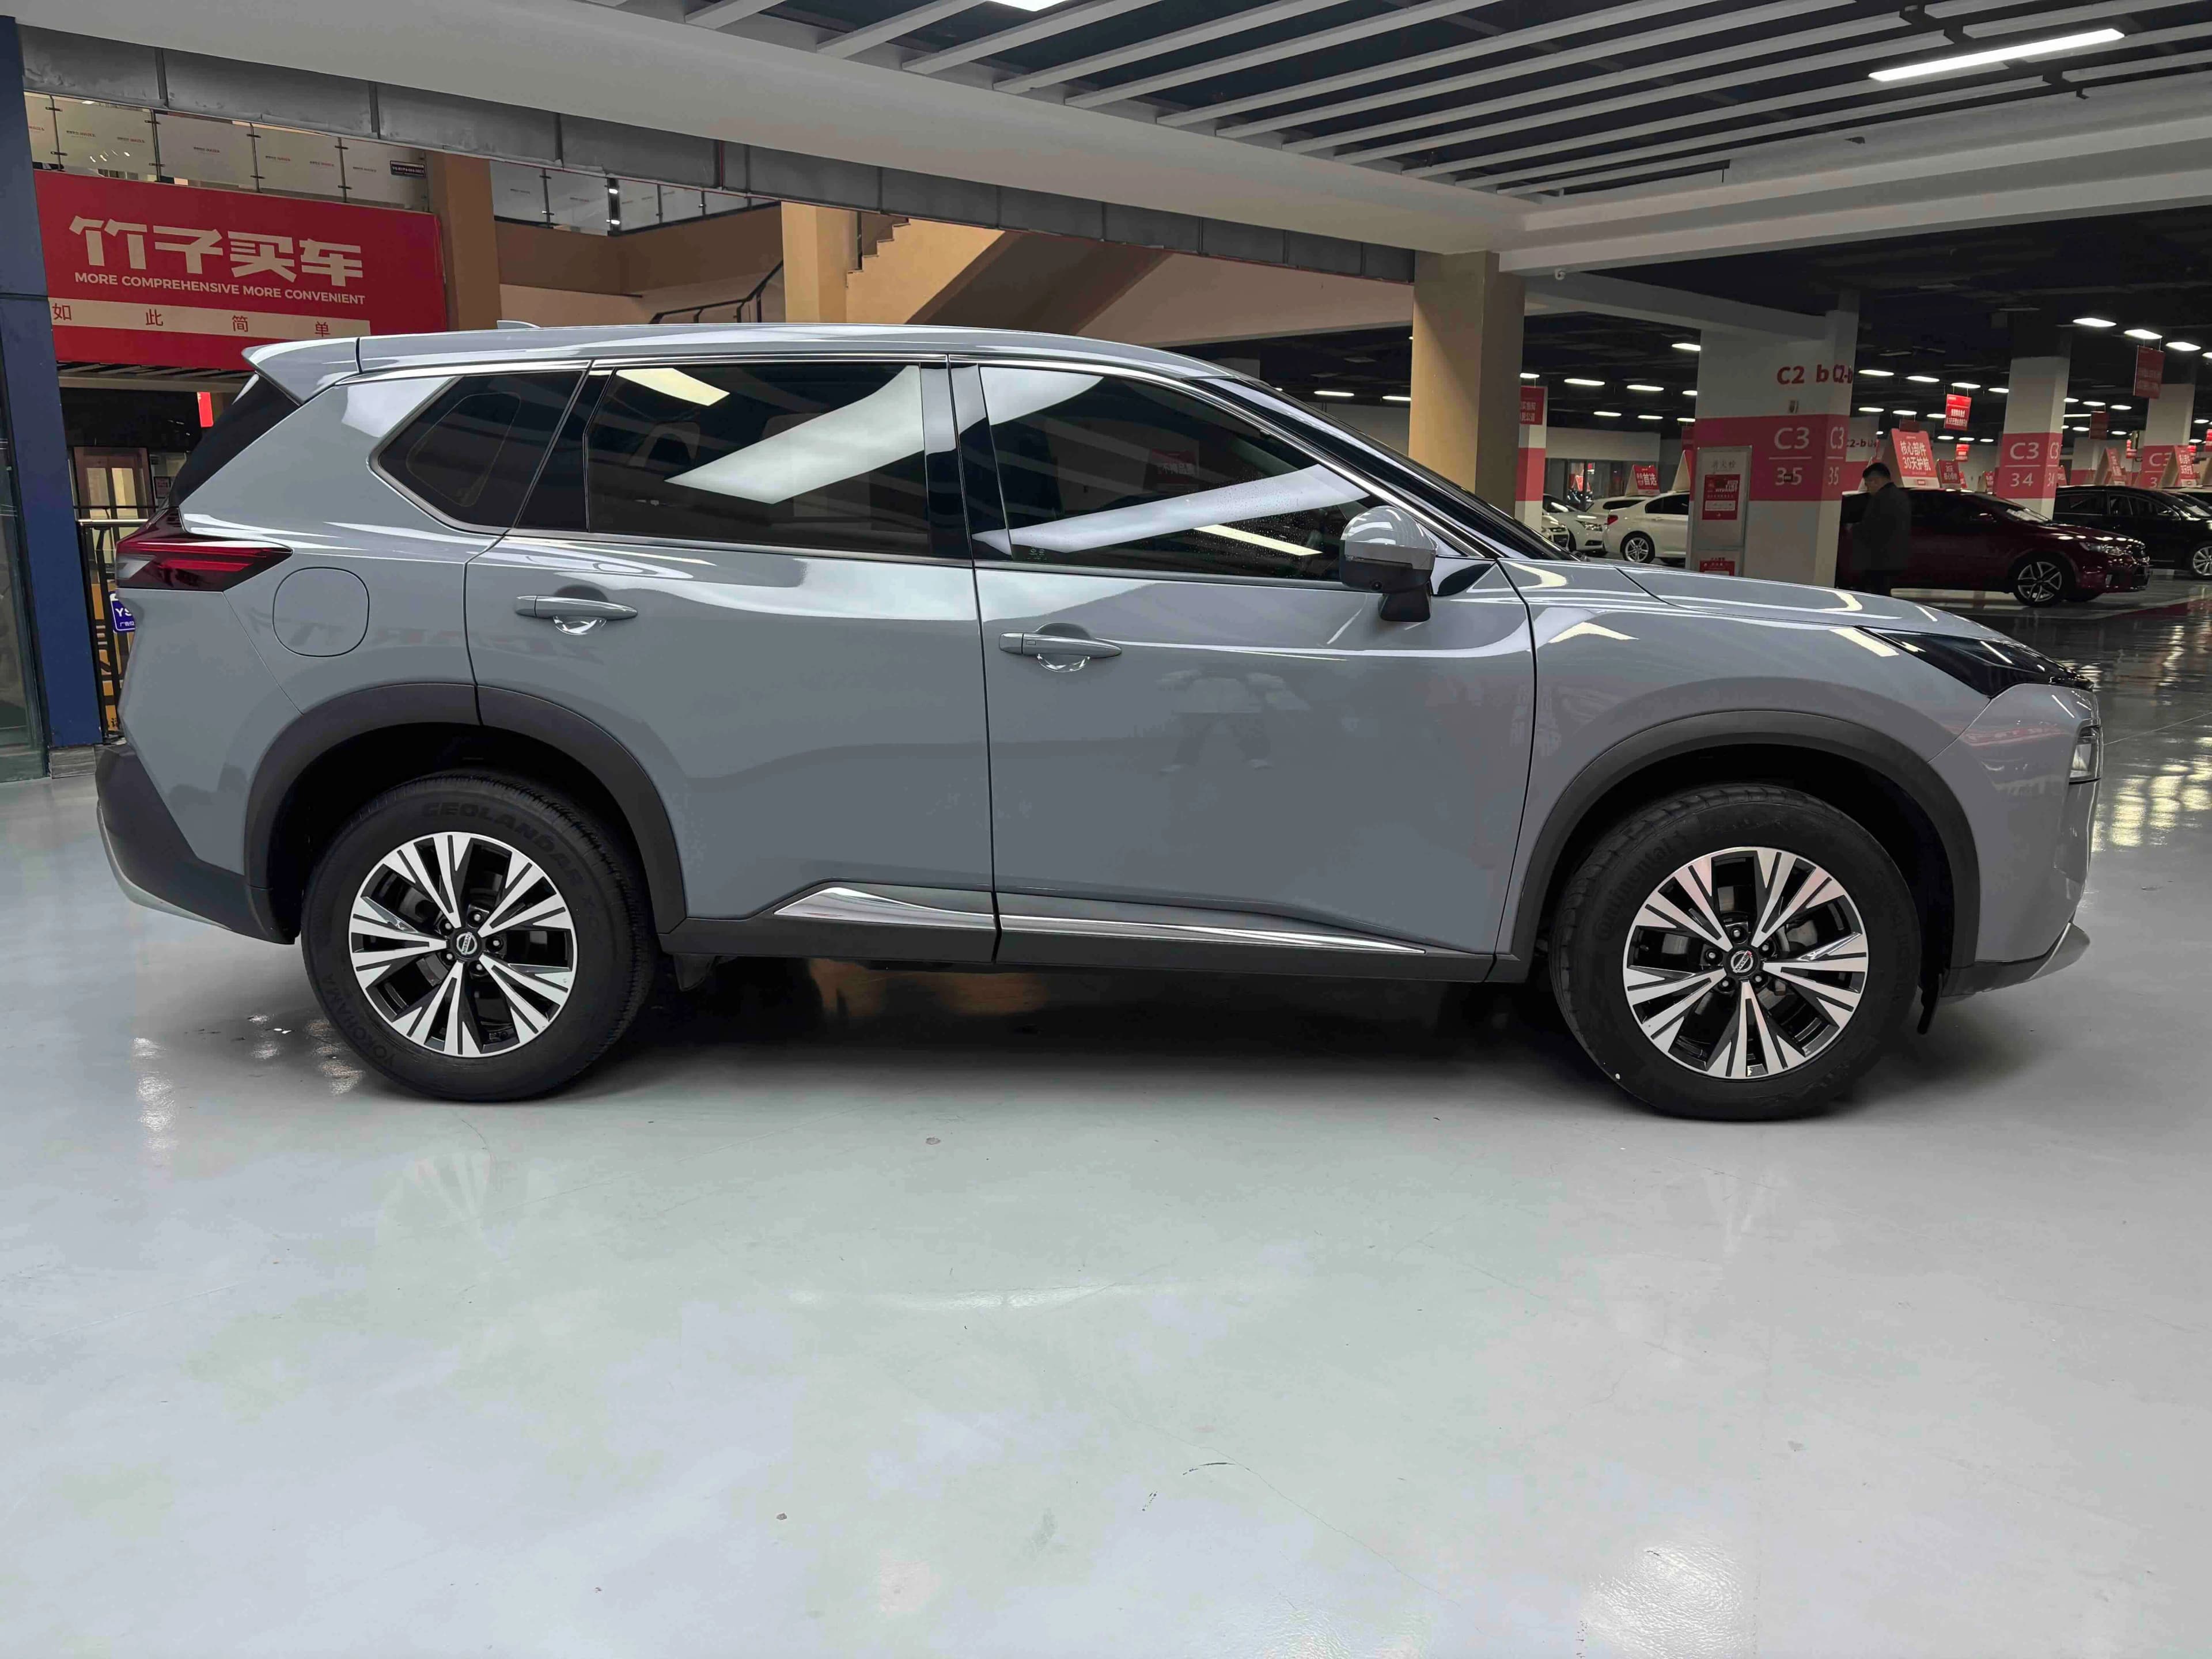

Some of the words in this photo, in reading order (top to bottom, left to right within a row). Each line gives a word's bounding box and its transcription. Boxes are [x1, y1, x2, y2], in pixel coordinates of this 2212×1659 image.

[69, 215, 363, 287] 竹子买车
[74, 272, 118, 285] MORE
[122, 275, 240, 295] COMPREHENSIVE
[243, 285, 282, 298] MORE
[285, 289, 366, 305] CONVENIENT
[1777, 366, 1805, 385] C2
[1774, 427, 1810, 450] C3
[1830, 427, 1844, 449] C3
[1846, 438, 1866, 447] 2-b
[1900, 440, 1926, 457] 核心部件
[2009, 442, 2040, 460] C3
[2050, 442, 2059, 459] C3
[1903, 456, 1931, 471] 30天护航
[1828, 467, 1839, 485] 35
[2010, 473, 2033, 487] 34
[2047, 472, 2055, 487] 34
[461, 933, 472, 955] NISSAN
